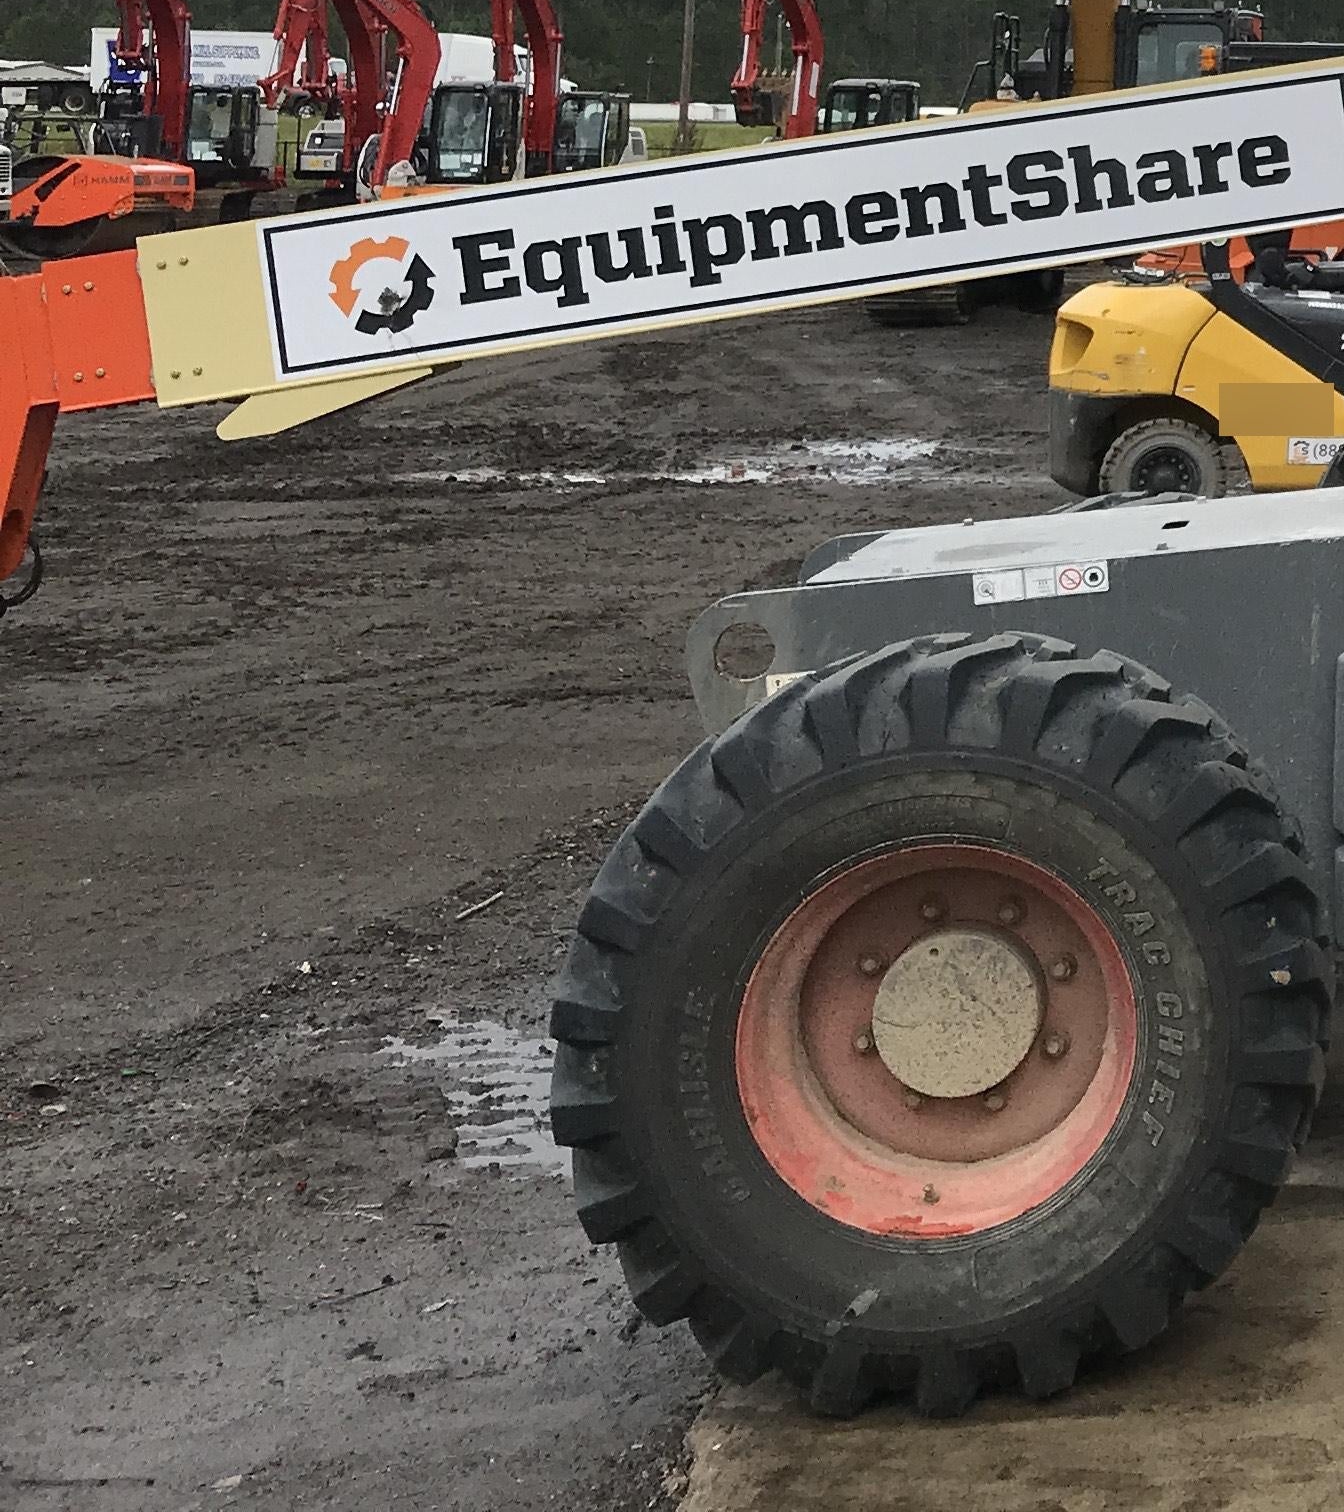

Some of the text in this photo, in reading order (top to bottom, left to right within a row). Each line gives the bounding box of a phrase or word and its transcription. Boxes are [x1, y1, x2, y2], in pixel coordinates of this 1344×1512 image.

[452, 134, 1292, 308] EquipmentShare
[1085, 856, 1184, 1147] TRAC CHIEF
